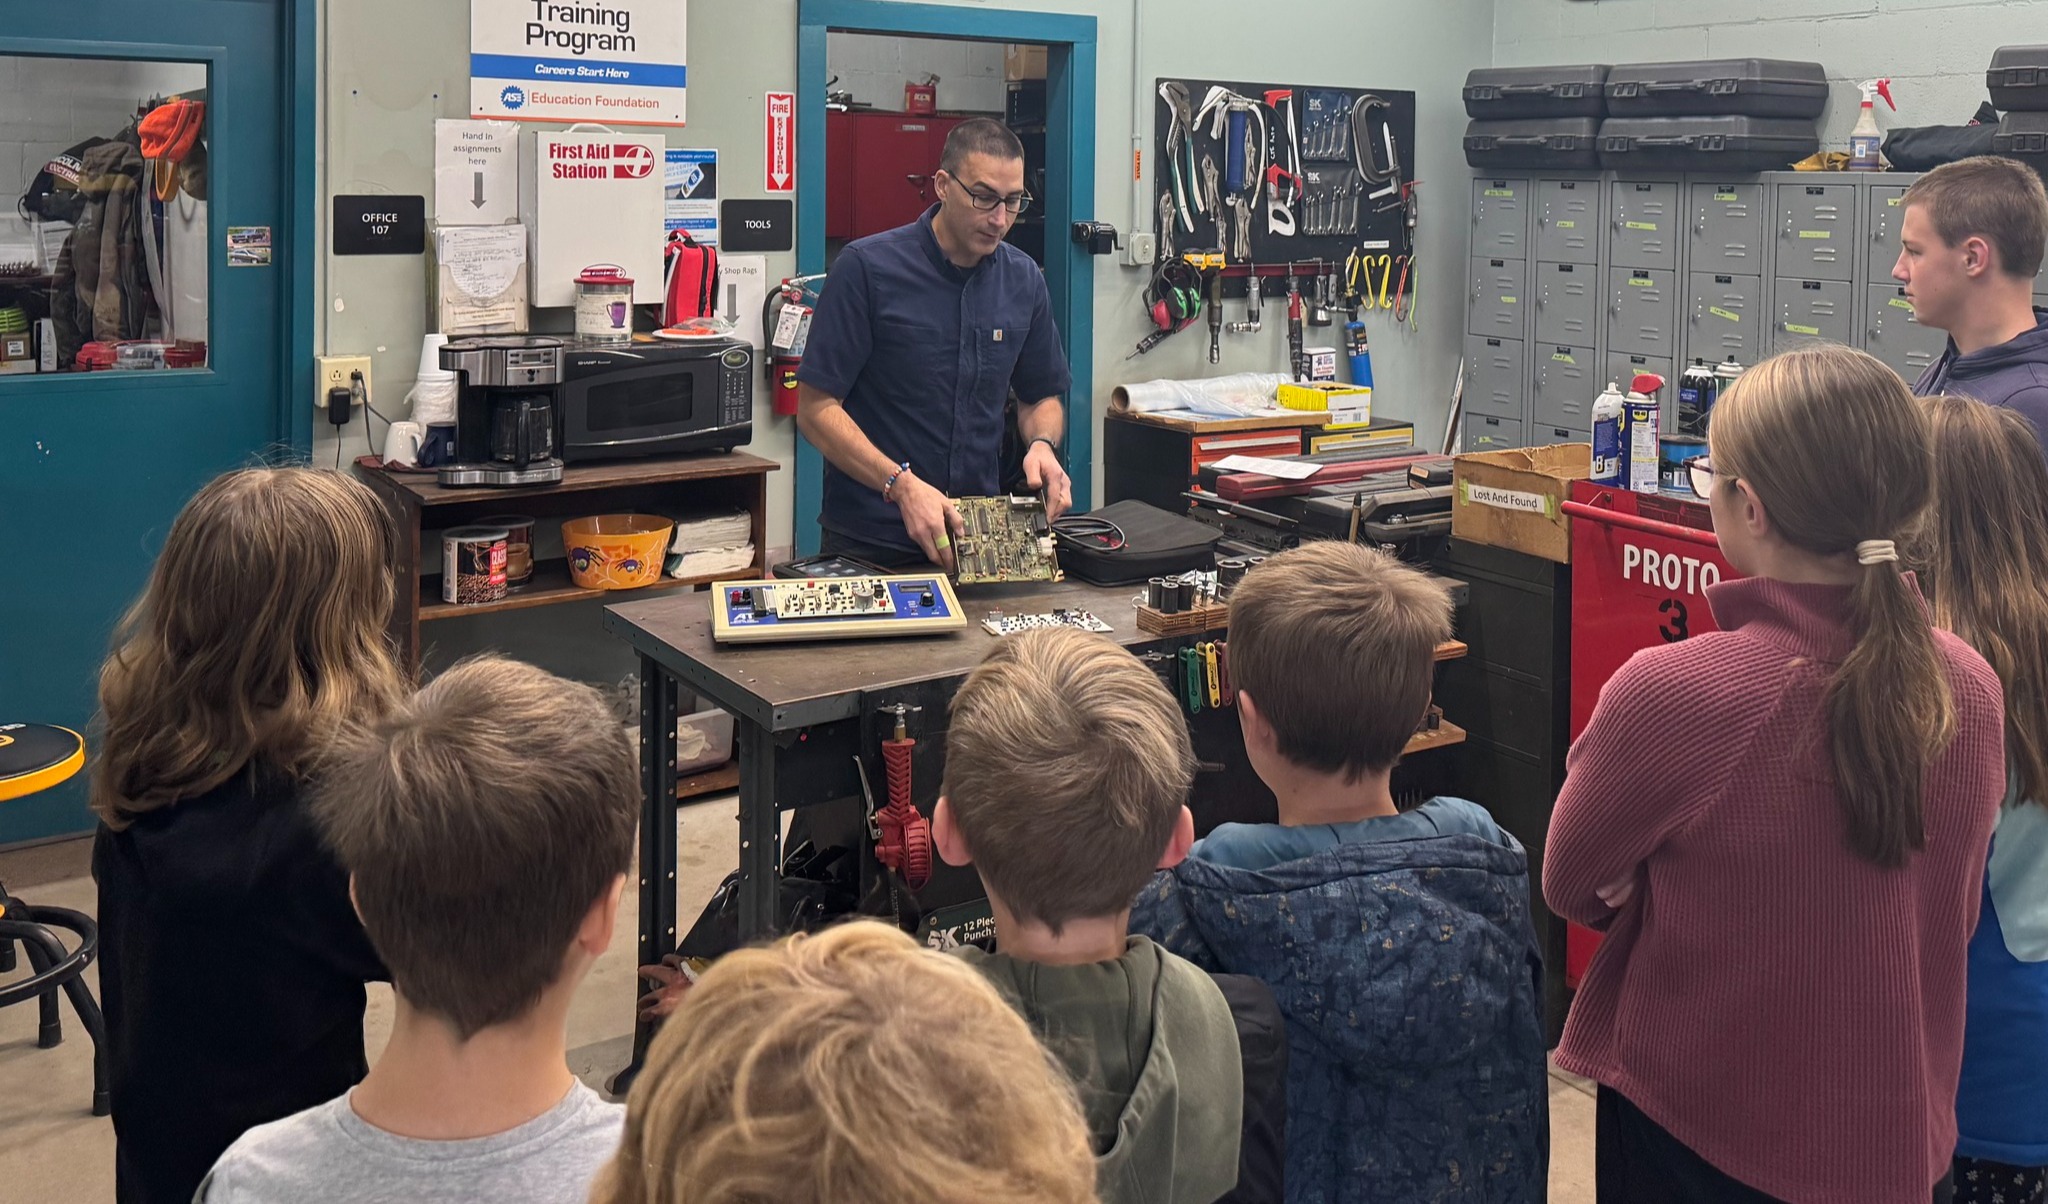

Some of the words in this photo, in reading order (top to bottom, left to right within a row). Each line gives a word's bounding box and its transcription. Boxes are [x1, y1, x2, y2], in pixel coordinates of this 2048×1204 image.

[531, 0, 630, 33] Training
[526, 22, 636, 55] Program
[535, 64, 575, 76] Careers
[577, 66, 604, 77] Start
[606, 68, 630, 79] Here
[502, 93, 523, 103] ASE
[531, 92, 592, 106] Education
[595, 94, 660, 109] Foundation
[1309, 99, 1321, 108] SK
[772, 104, 789, 113] FIRE
[462, 131, 484, 141] Hand
[485, 132, 493, 141] In
[453, 144, 502, 154] assignments
[550, 143, 584, 160] First
[586, 144, 610, 160] Aid
[468, 157, 487, 165] here
[552, 162, 607, 179] Station
[1307, 172, 1320, 181] SK
[362, 213, 398, 223] OFFICE
[745, 220, 771, 229] TOOLS
[371, 225, 389, 235] 107
[724, 266, 741, 275] Shop
[743, 266, 757, 275] Rags
[1474, 489, 1490, 501] Lost
[1492, 492, 1508, 503] And
[1510, 495, 1537, 508] Found
[1623, 543, 1720, 597] PROTO
[1658, 598, 1688, 643] 3
[964, 921, 975, 931] 12
[976, 917, 995, 929] Piec
[964, 927, 992, 942] Punch
